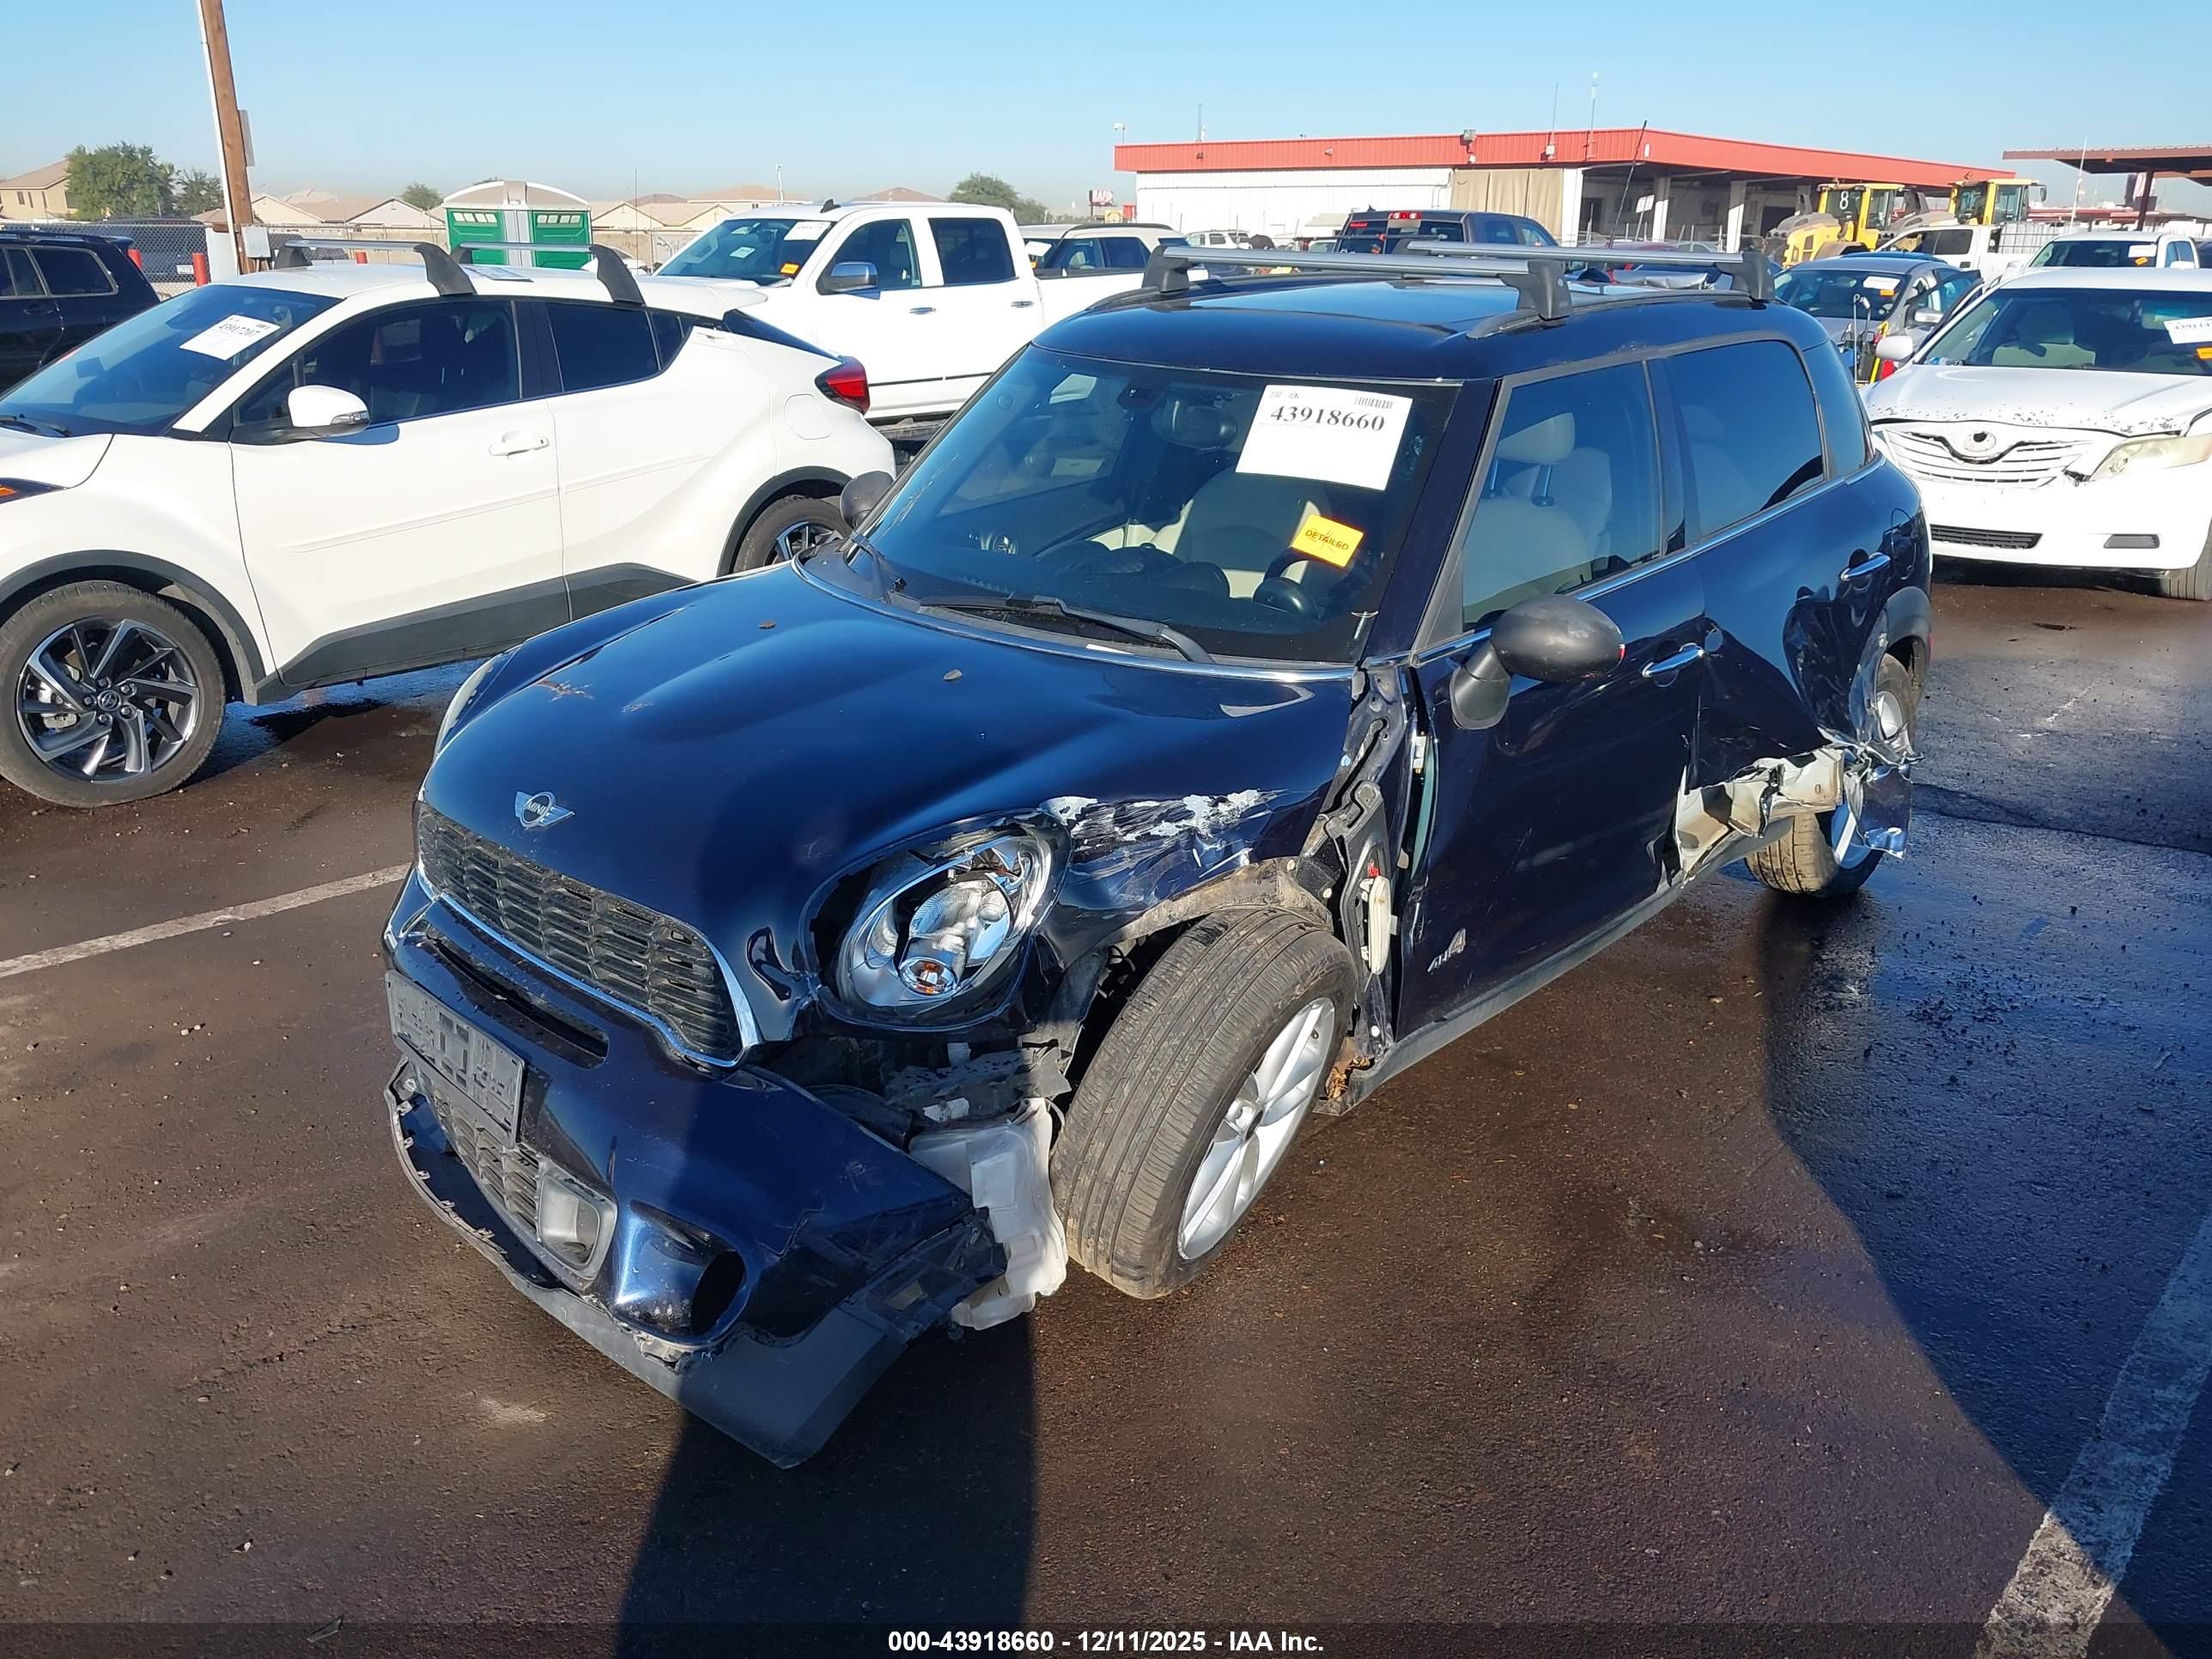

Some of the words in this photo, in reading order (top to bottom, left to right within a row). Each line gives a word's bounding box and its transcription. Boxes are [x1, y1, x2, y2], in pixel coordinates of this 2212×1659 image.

[1839, 190, 1849, 210] 8
[1270, 405, 1386, 432] 43918660
[1305, 529, 1349, 550] DETAILED
[526, 800, 548, 816] MINI
